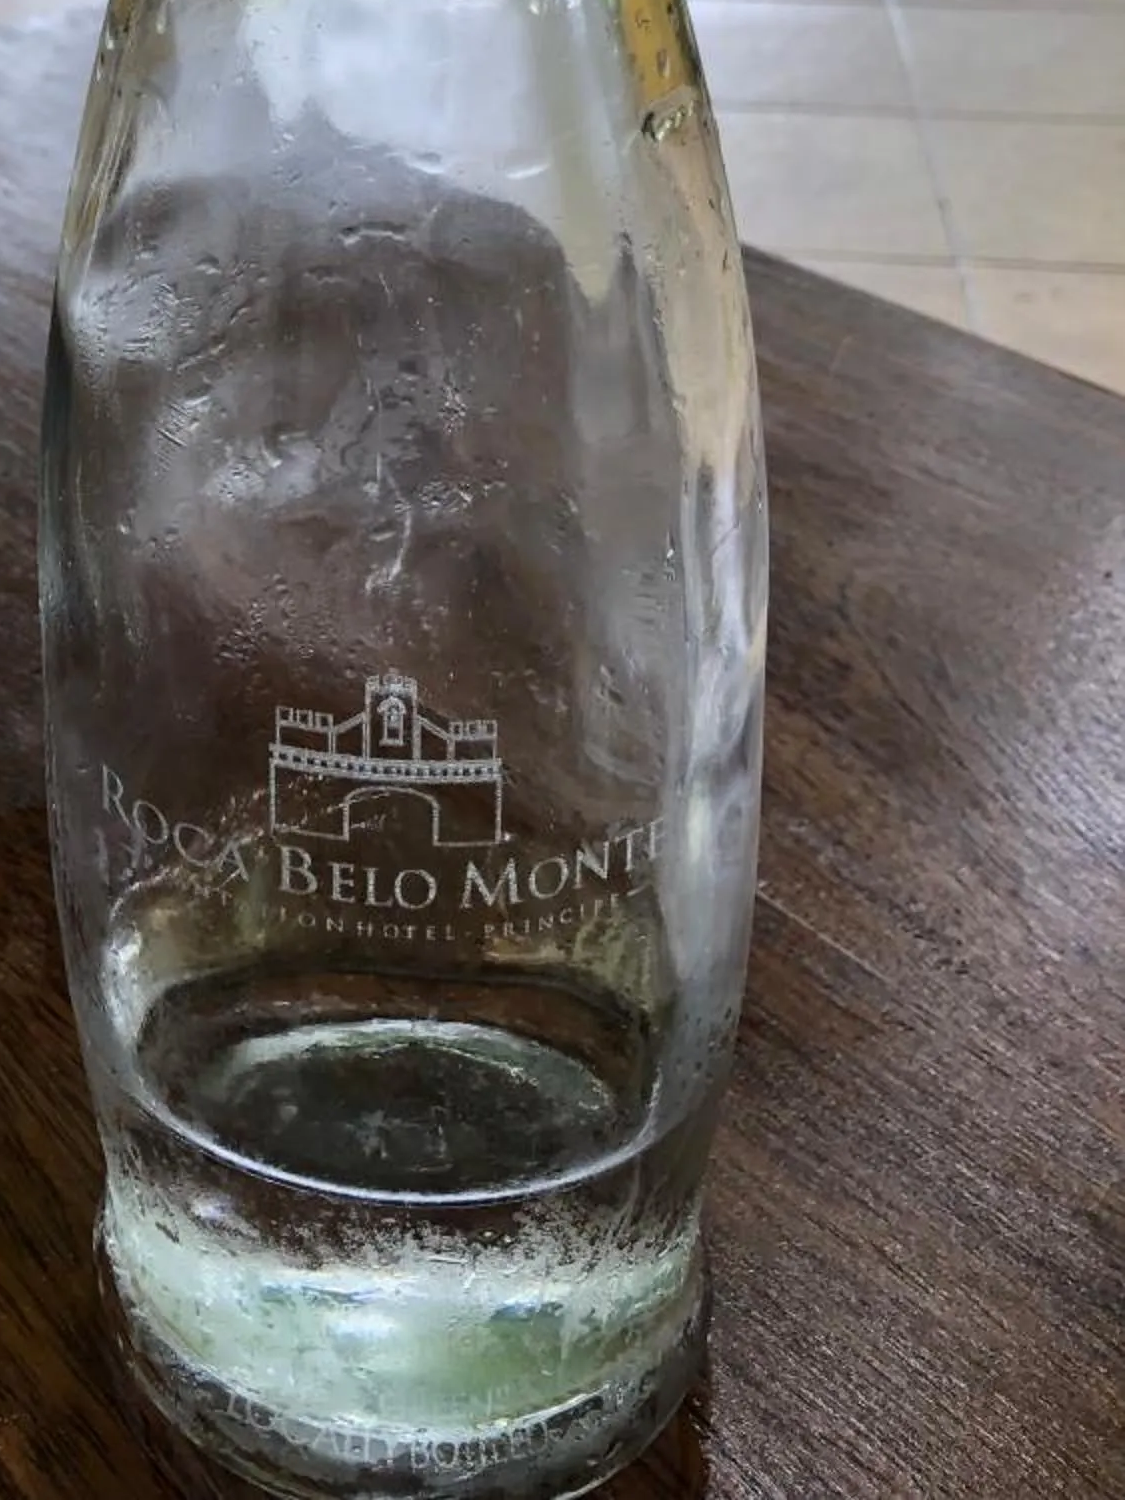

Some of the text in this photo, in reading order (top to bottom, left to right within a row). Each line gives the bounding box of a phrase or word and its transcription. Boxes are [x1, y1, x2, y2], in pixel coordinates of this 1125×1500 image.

[99, 761, 666, 911] ROCA BELO MONTE
[355, 920, 457, 942] HOTEL
